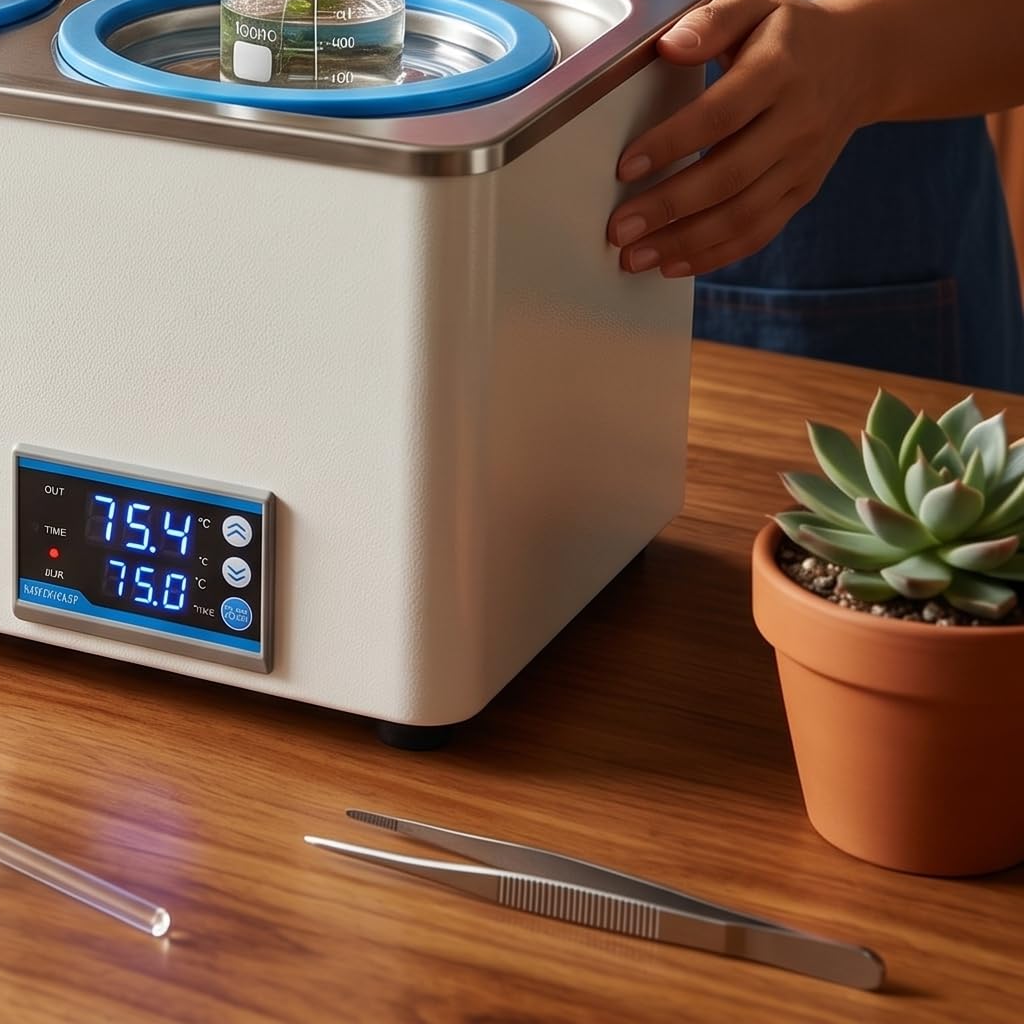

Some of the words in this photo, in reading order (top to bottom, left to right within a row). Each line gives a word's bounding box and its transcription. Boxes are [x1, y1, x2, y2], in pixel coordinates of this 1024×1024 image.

[44, 485, 65, 496] OUT
[44, 525, 67, 537] TIME
[94, 495, 192, 556] 75.4
[109, 559, 187, 610] 75.0
